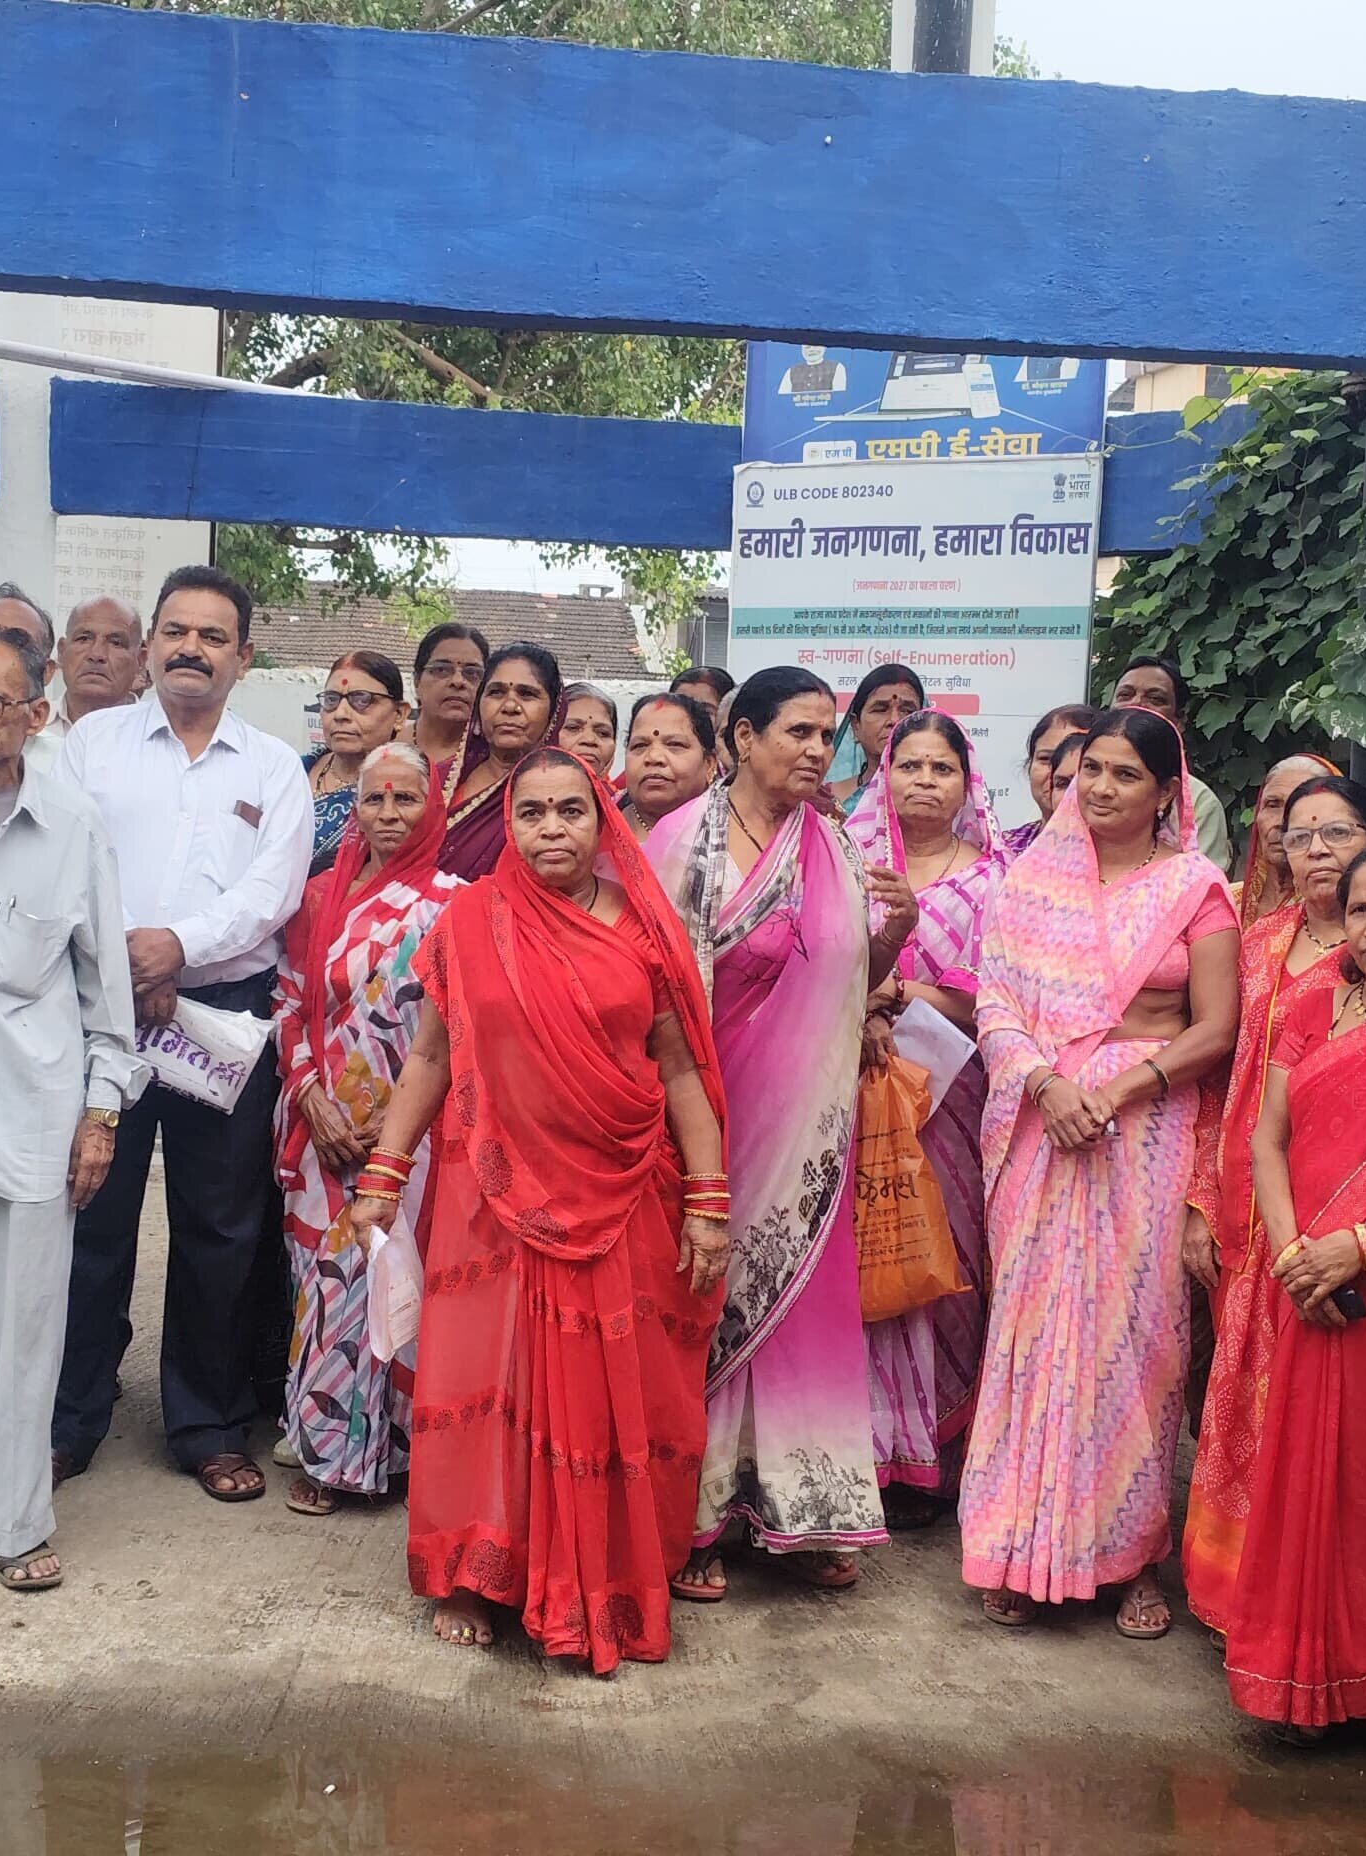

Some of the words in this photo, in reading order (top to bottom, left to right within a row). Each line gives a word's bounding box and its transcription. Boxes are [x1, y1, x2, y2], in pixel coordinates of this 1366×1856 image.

[865, 430, 939, 460] एमपी
[947, 427, 1042, 459] ई-सेवा
[774, 488, 797, 500] ULB
[801, 487, 838, 500] CODE
[842, 485, 893, 499] 802340
[1068, 480, 1091, 490] भारत
[738, 517, 806, 559] हमारी
[810, 525, 925, 562] जनगणना,
[933, 524, 1006, 557] हमारा
[1010, 513, 1093, 556] विकास
[798, 649, 864, 665] स्व-गणना
[868, 646, 1016, 670] (Self-Enumeration)
